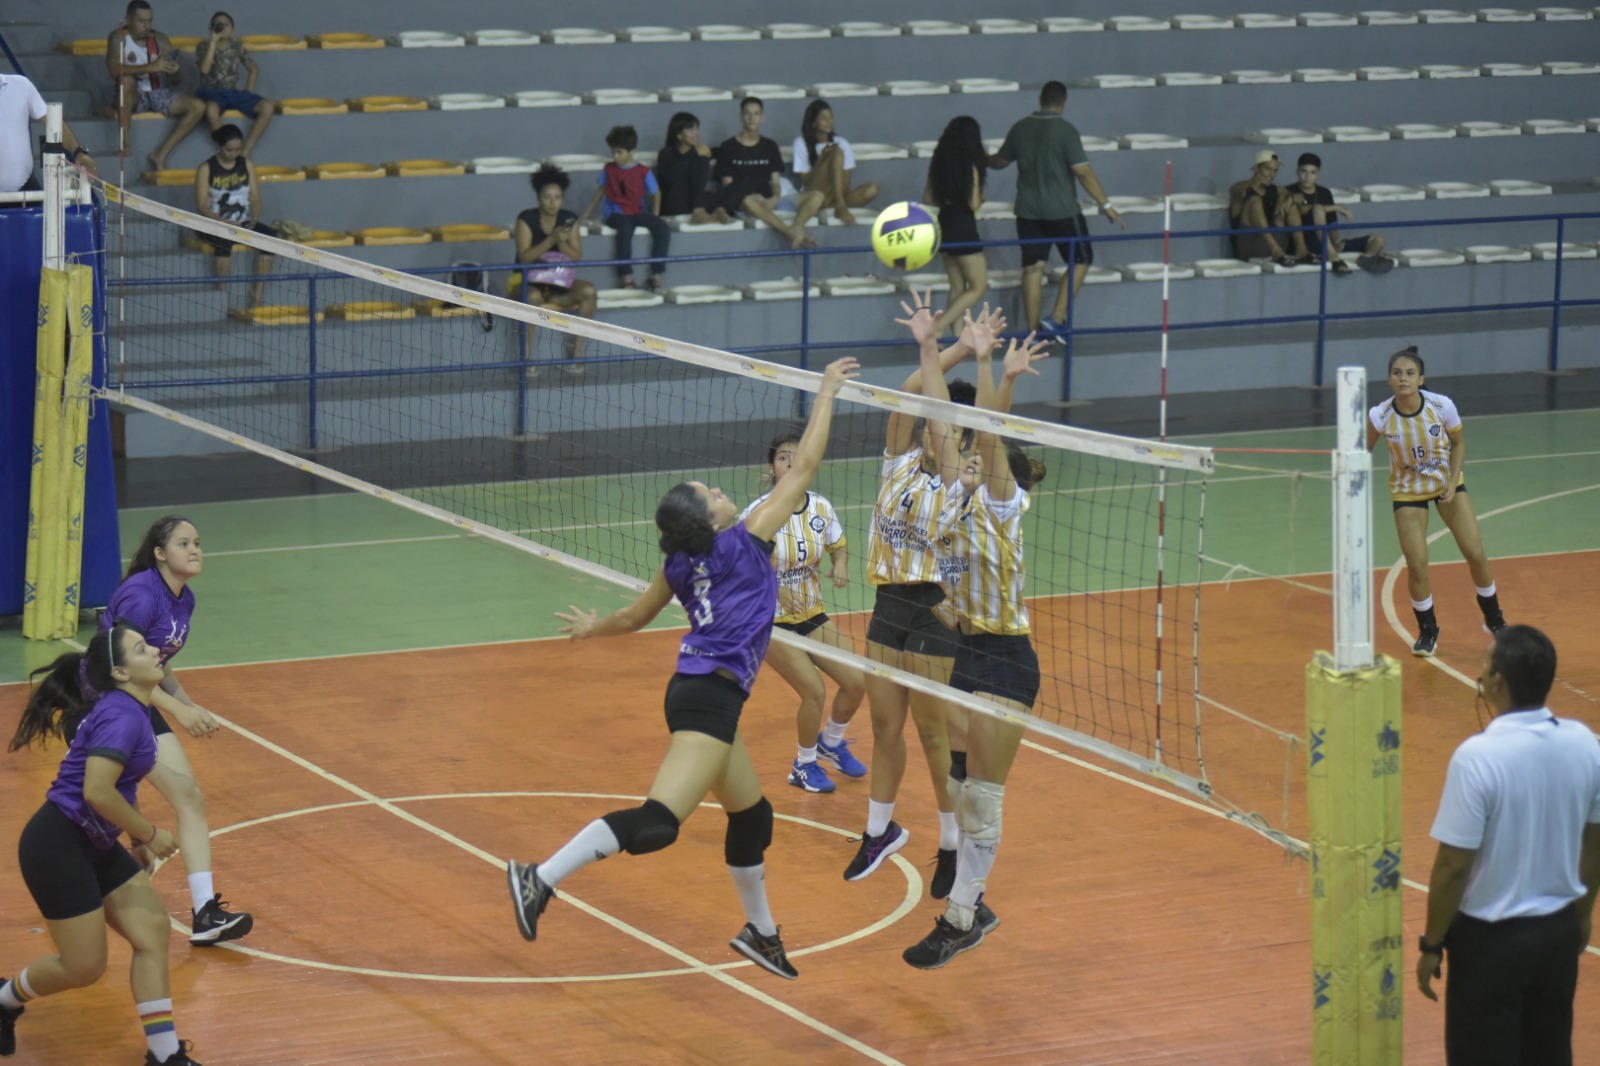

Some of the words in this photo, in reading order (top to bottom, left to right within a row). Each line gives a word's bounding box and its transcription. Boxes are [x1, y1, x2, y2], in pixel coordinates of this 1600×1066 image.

[887, 228, 915, 247] FAV
[1411, 445, 1426, 459] 15
[901, 492, 914, 514] 4
[797, 540, 807, 562] 5
